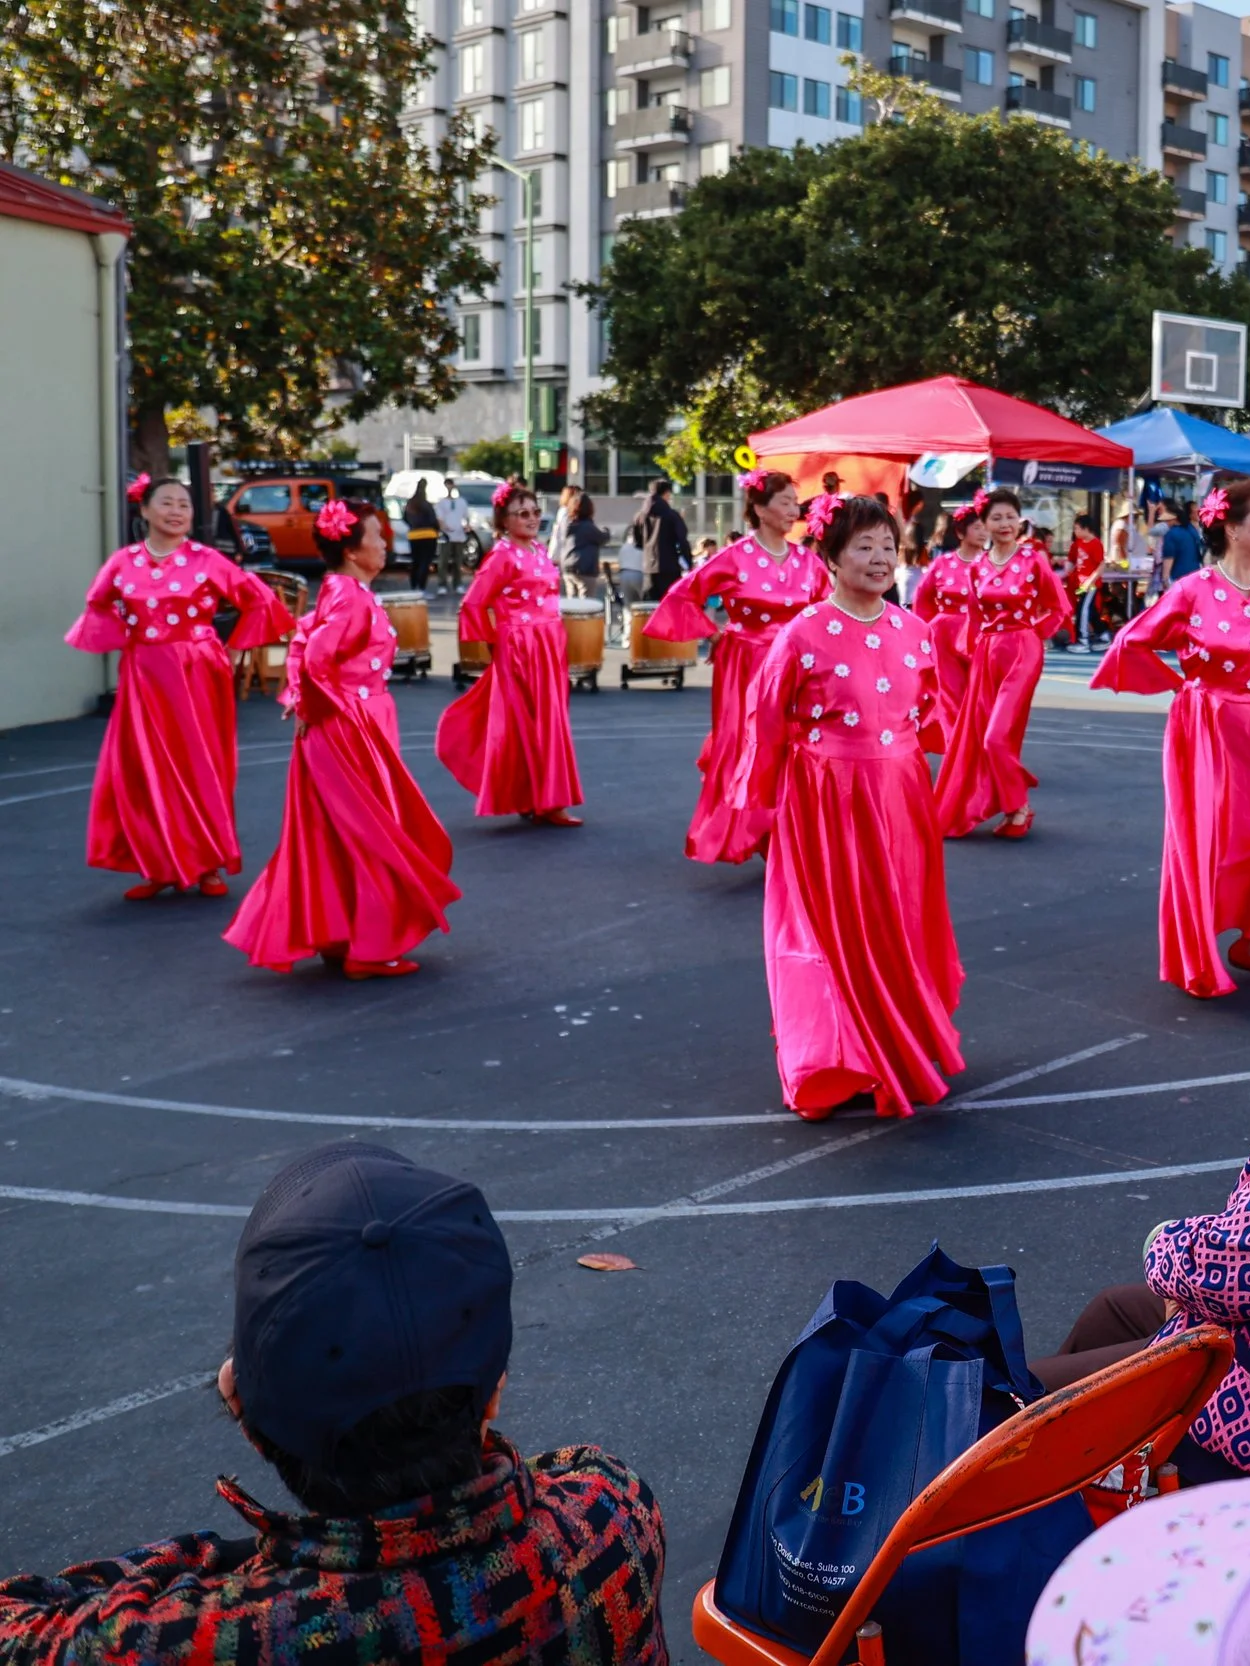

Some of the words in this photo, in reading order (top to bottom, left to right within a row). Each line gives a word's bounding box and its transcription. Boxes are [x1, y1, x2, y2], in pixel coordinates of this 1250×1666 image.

[816, 1562, 839, 1573] Suite
[841, 1565, 856, 1574] 100
[807, 1573, 820, 1583] CA
[822, 1576, 846, 1586] 94577
